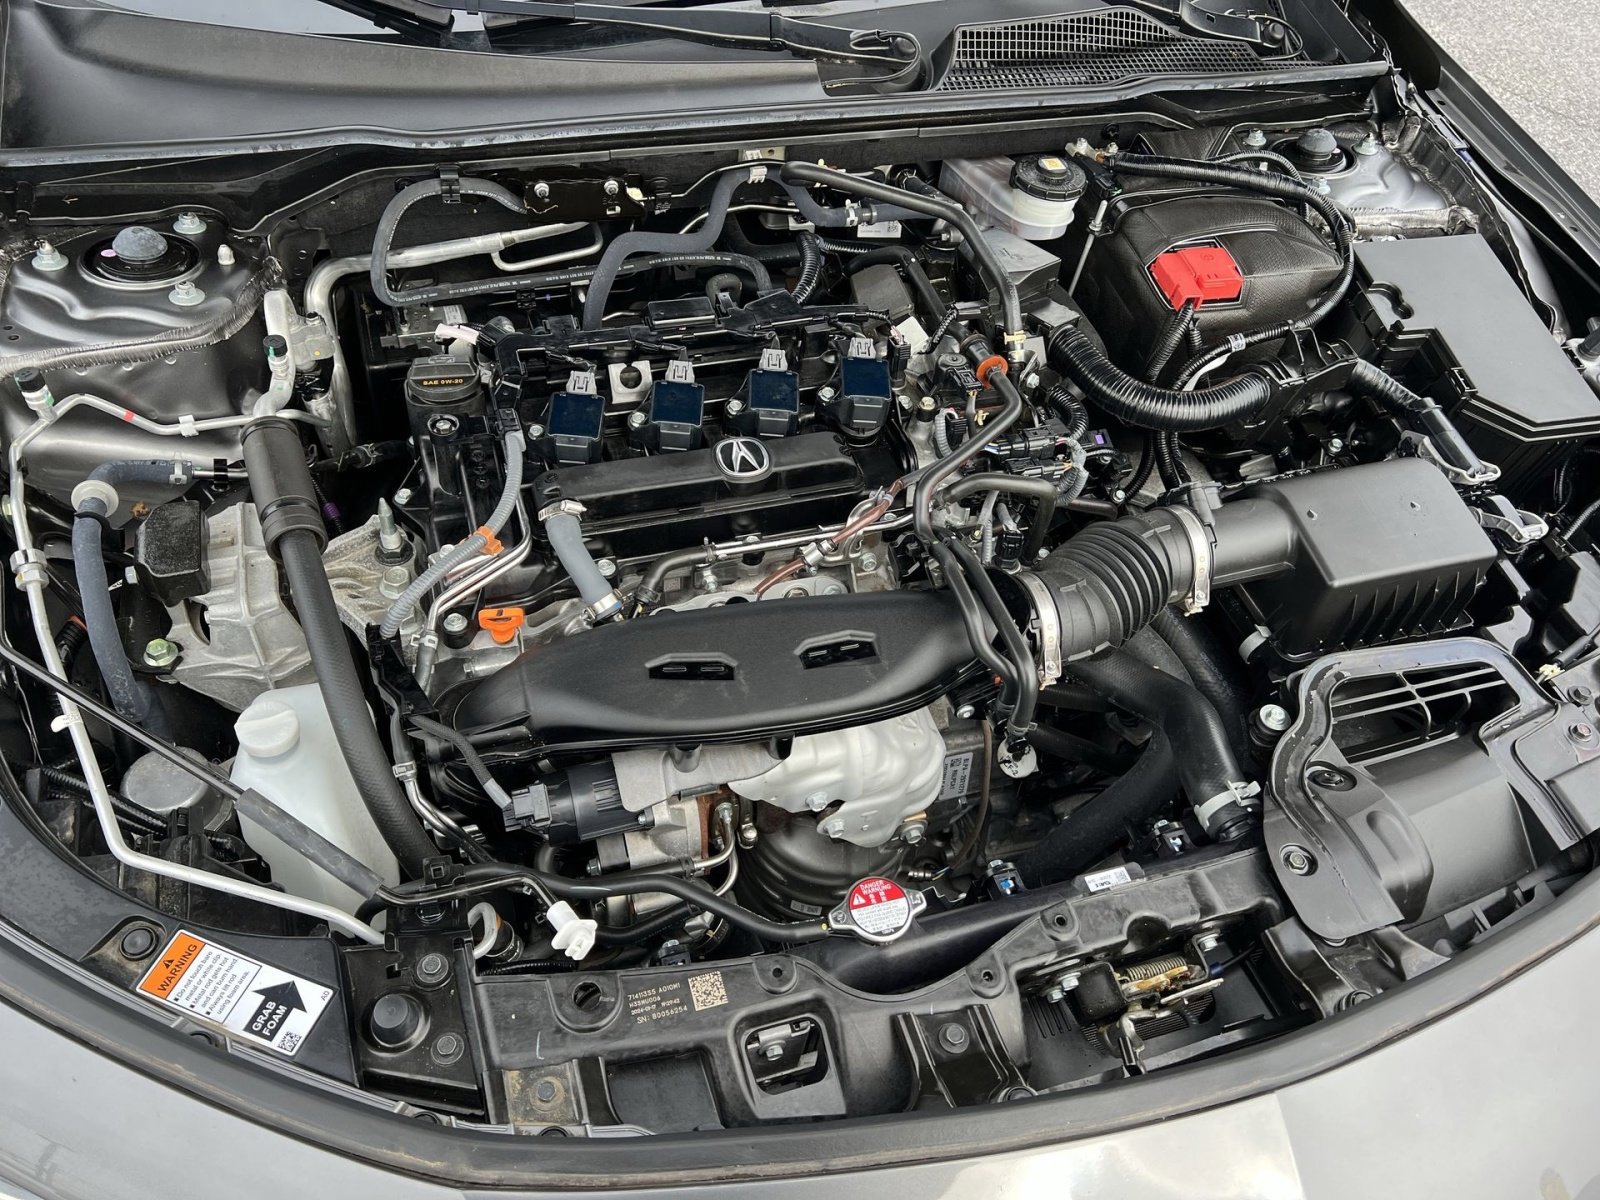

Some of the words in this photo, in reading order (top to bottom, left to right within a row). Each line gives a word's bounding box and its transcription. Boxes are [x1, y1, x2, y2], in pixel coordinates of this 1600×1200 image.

[860, 880, 884, 890] DANGER
[863, 883, 892, 895] WARNING
[157, 944, 197, 991] WARNING
[176, 989, 186, 998] Do
[184, 979, 193, 989] not
[190, 964, 204, 979] touch
[201, 951, 213, 964] bare
[185, 985, 198, 1001] metal
[201, 964, 214, 978] white
[212, 954, 221, 964] clip.
[192, 989, 206, 1004] Metal
[205, 979, 213, 989] rod
[211, 967, 222, 979] gets
[219, 957, 229, 966] hot
[201, 996, 211, 1008] and
[209, 986, 219, 996] can
[216, 973, 228, 985] burn
[209, 992, 225, 1011] Always
[228, 974, 237, 984] rod
[217, 999, 231, 1014] using
[227, 985, 240, 999] foam
[252, 1001, 276, 1031] GRAB
[262, 1005, 287, 1036] FOAM
[636, 1015, 650, 1024] SN:
